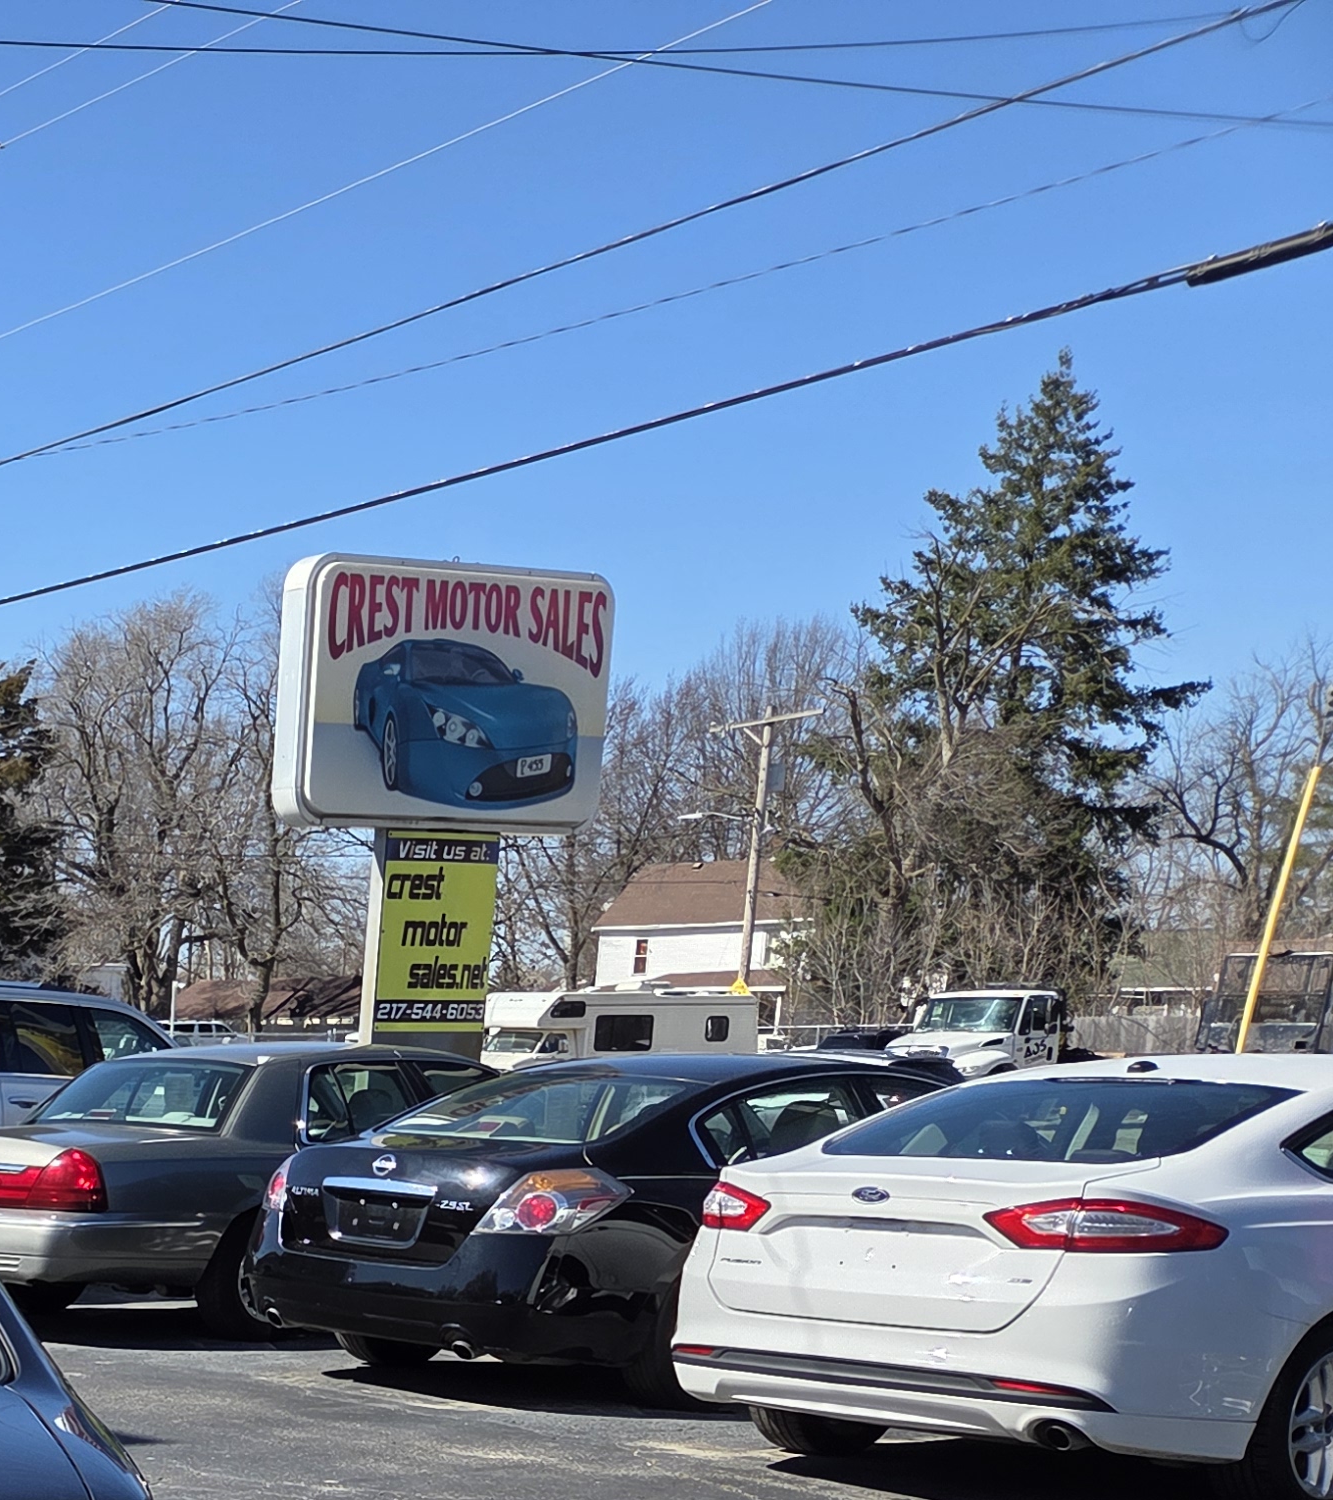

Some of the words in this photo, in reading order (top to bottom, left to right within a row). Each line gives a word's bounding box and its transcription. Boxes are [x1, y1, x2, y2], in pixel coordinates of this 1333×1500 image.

[328, 571, 420, 661] CREST
[424, 579, 521, 639] MOTOR
[528, 586, 607, 678] SALES
[399, 840, 437, 859] Visit
[443, 845, 465, 860] us
[470, 843, 491, 861] at:
[386, 866, 445, 900] crest
[401, 913, 468, 948] motor
[407, 955, 487, 990] sales.net
[377, 1002, 485, 1021] 217-544-6053
[291, 1184, 320, 1197] ALTIMA
